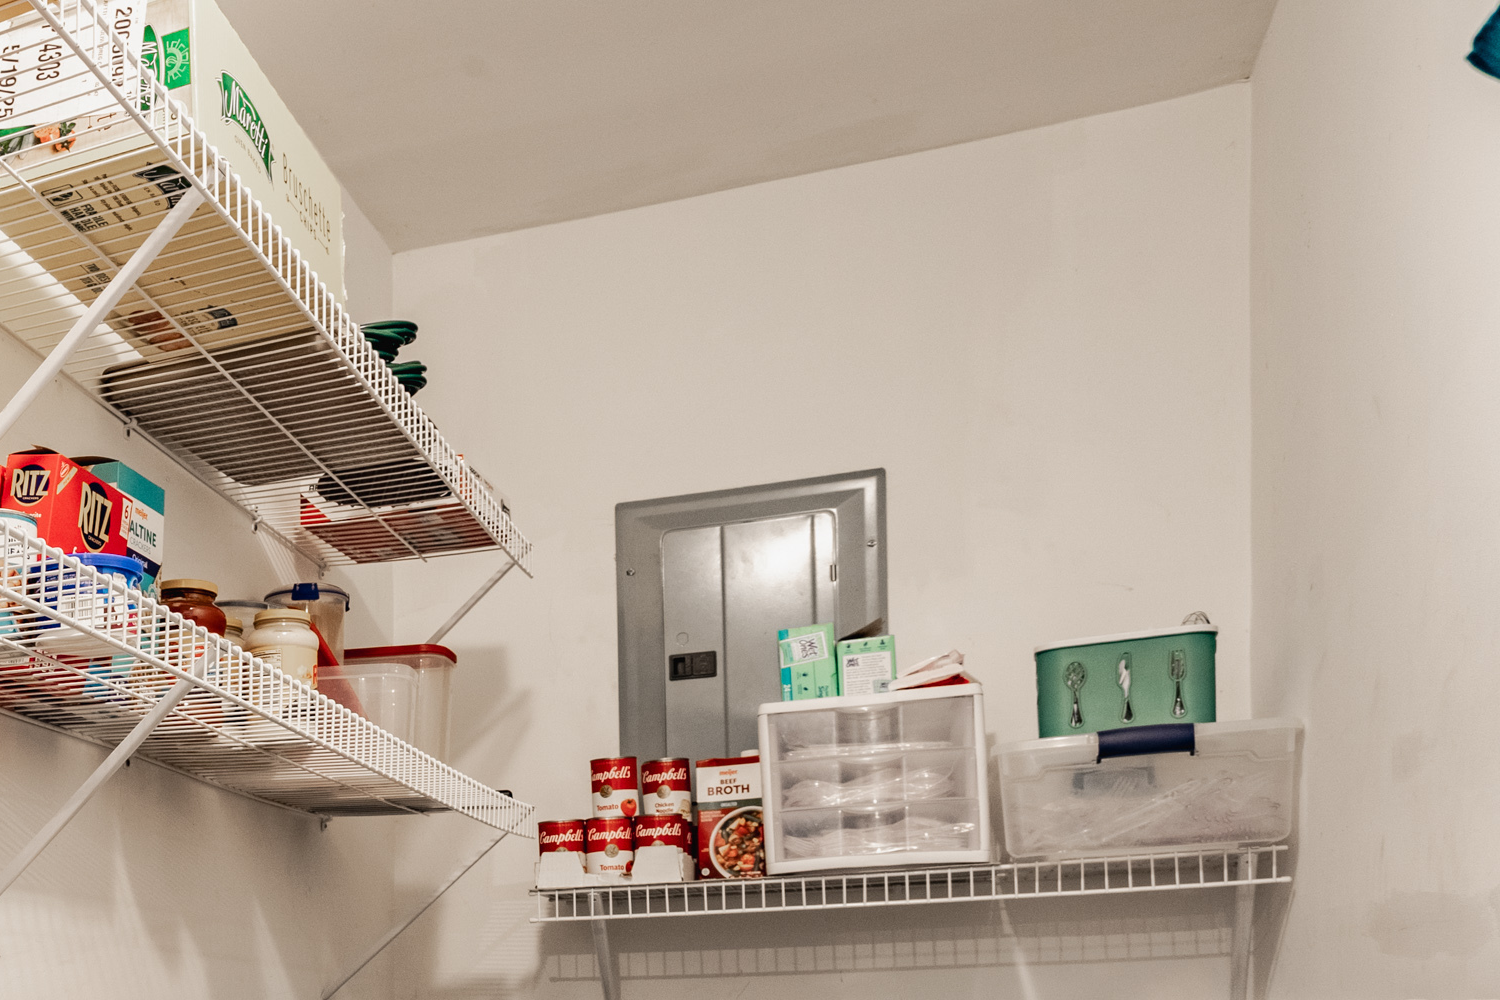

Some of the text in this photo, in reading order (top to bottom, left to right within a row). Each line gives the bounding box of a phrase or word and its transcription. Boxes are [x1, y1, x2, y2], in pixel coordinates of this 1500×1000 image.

[222, 80, 269, 159] Maretti
[282, 152, 331, 243] Bruschette
[10, 467, 51, 498] RITZ
[77, 481, 113, 543] RITZ
[597, 803, 619, 812] Tomato
[707, 784, 751, 797] BROTH
